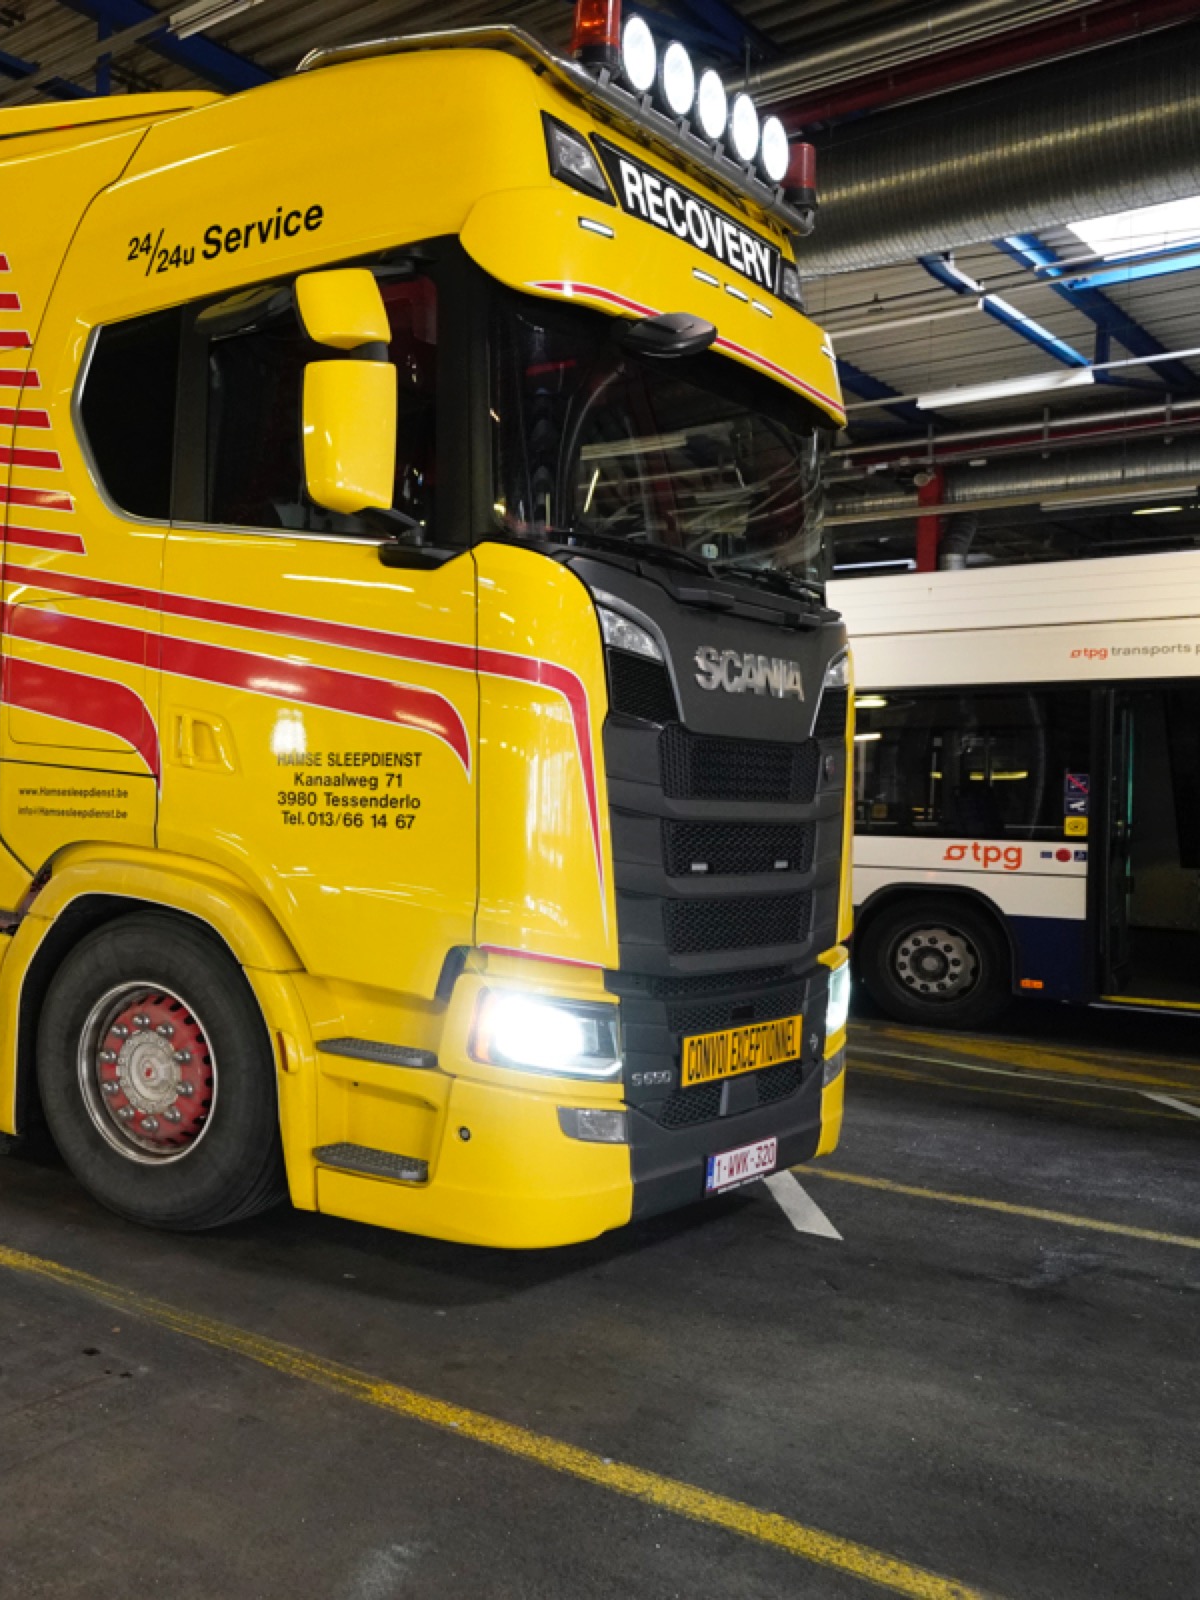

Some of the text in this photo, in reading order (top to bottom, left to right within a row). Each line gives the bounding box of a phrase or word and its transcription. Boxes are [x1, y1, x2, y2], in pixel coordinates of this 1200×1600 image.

[202, 203, 324, 260] Service
[619, 158, 773, 289] RECOVERY
[1111, 643, 1192, 658] transports
[694, 645, 805, 702] SCANIA
[327, 752, 423, 767] SLEEPDIENST
[294, 772, 403, 791] Kanaalweg 71
[277, 791, 421, 809] 3980 Tessenderlo
[371, 813, 388, 829] 14
[395, 813, 416, 830] 67
[687, 1018, 798, 1082] CONVOI EXCEPTIONNEL
